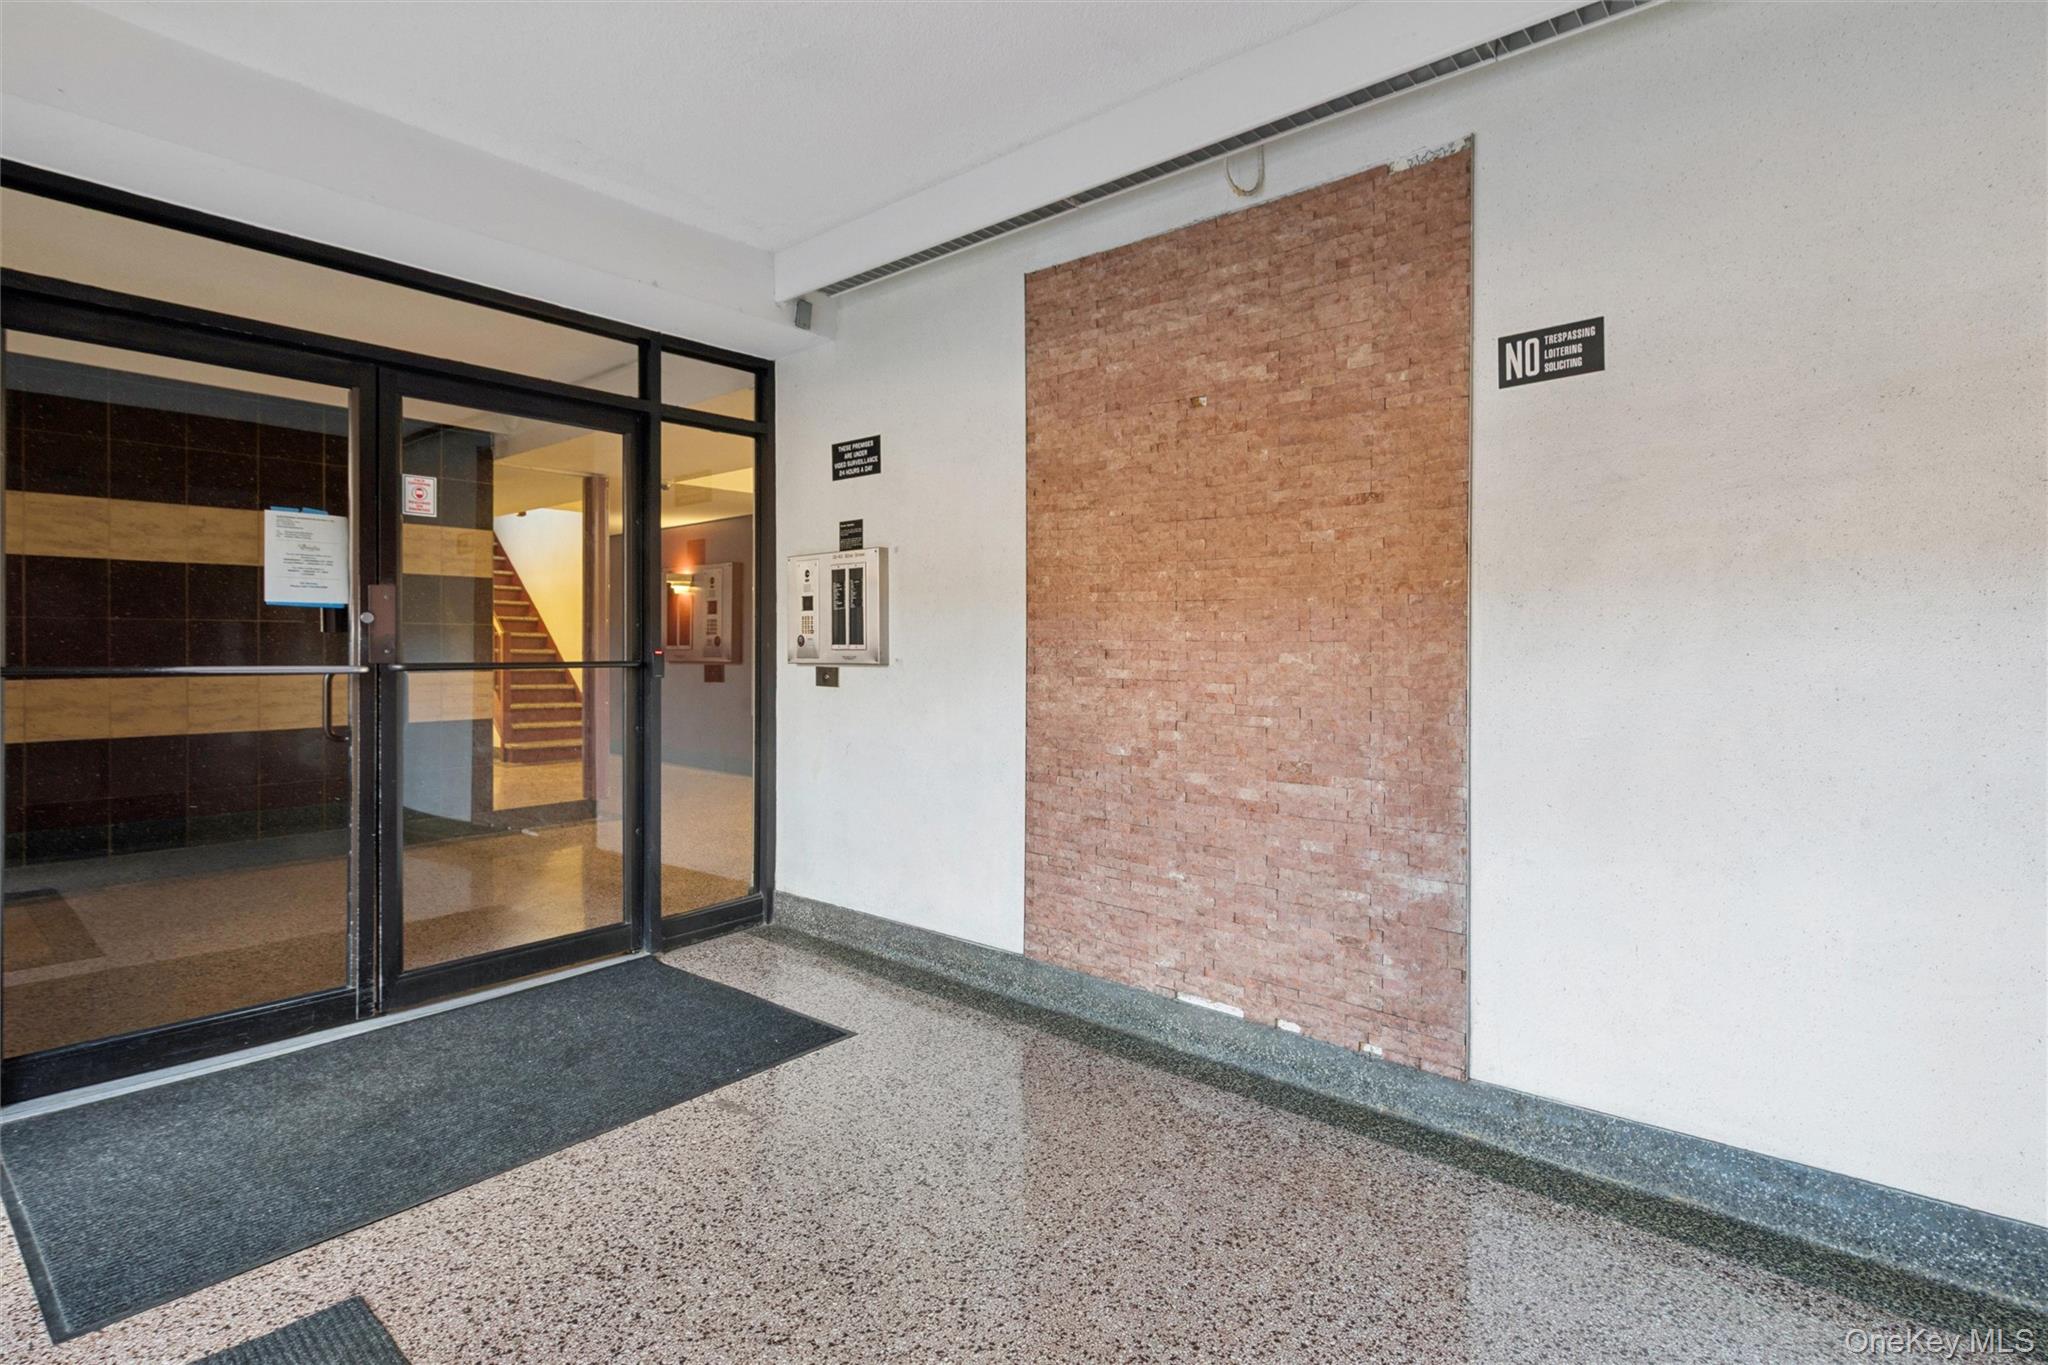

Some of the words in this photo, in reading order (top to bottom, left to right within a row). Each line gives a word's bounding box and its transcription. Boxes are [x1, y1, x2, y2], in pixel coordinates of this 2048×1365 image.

[1544, 326, 1596, 345] TRESPASSING
[1505, 337, 1540, 381] NO
[1544, 343, 1583, 360] LOITERING
[1544, 356, 1583, 373] SOLICITING
[834, 461, 846, 470] VIDEO
[847, 455, 879, 467] SURVEILLANCE
[846, 467, 860, 475] HOURS
